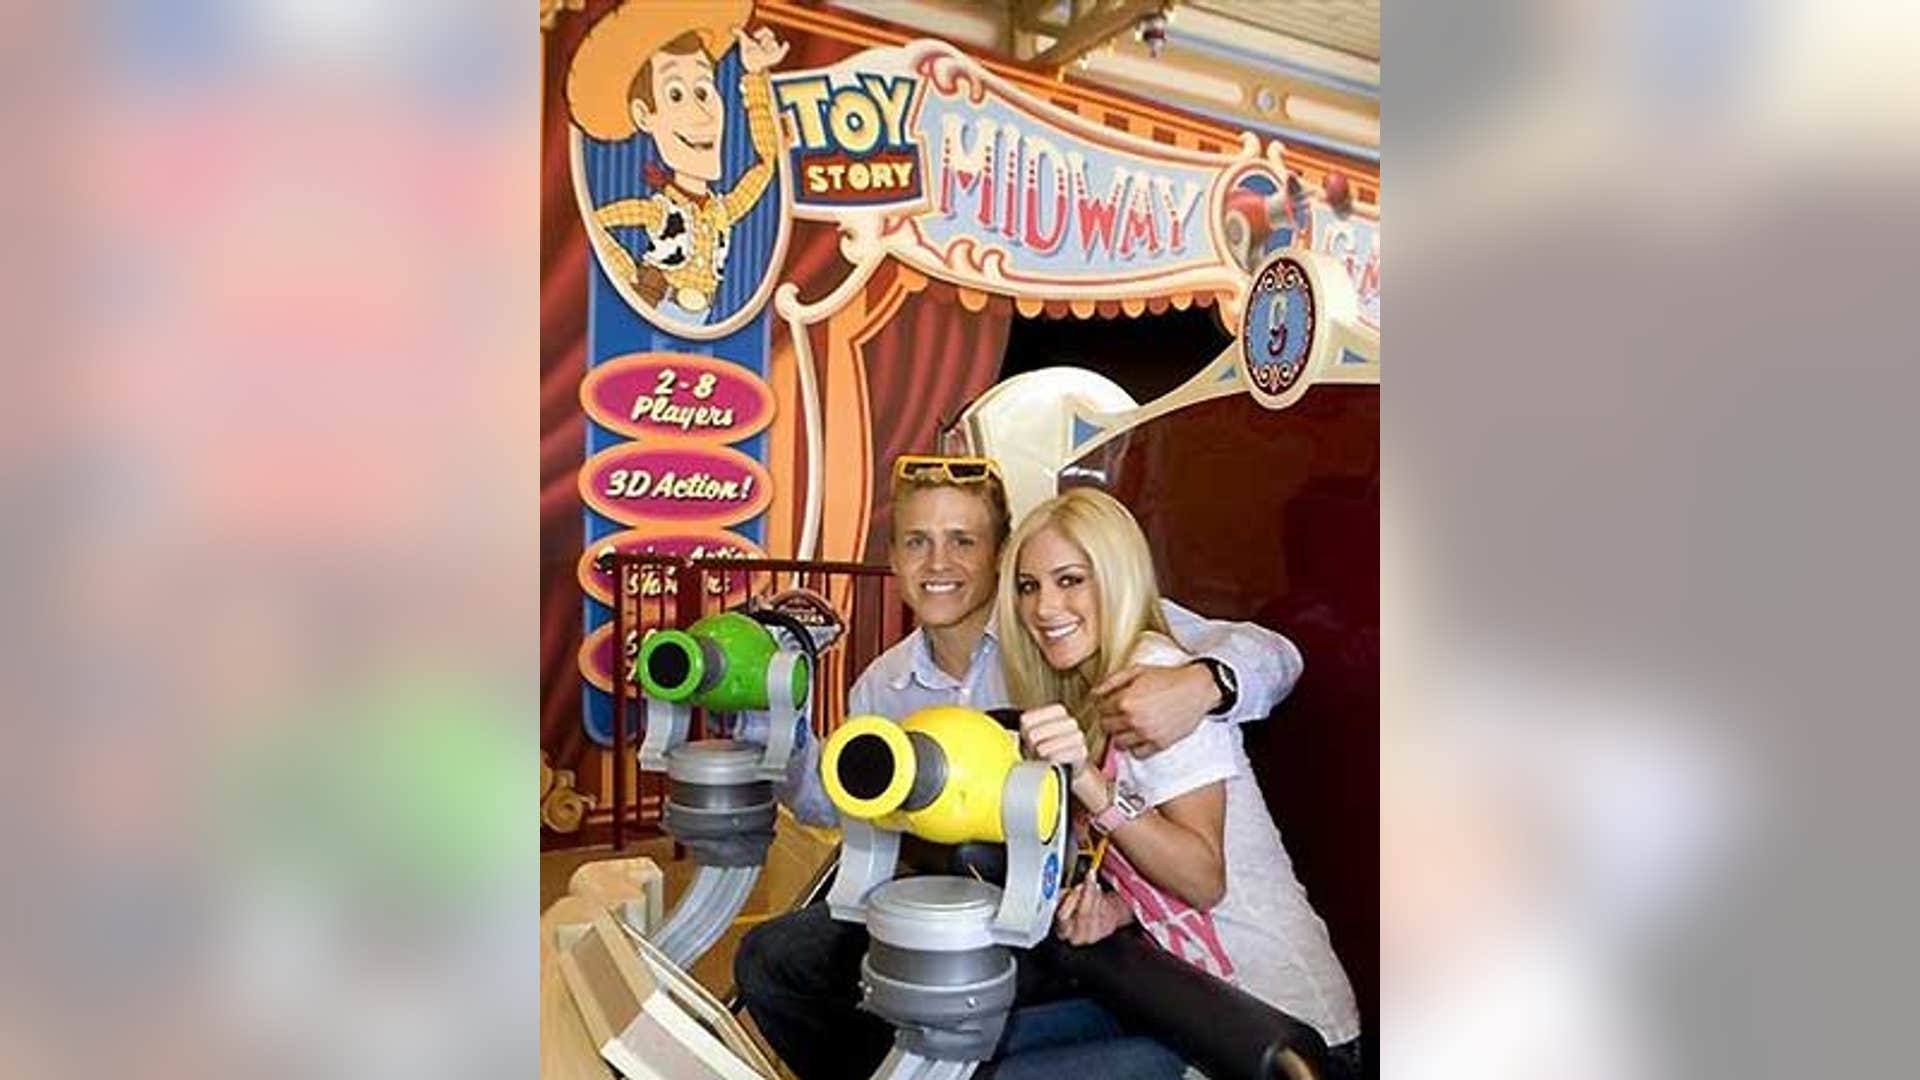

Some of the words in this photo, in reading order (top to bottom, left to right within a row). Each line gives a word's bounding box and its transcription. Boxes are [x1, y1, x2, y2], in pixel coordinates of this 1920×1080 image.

[774, 73, 915, 155] TOY
[807, 162, 914, 193] STORY
[937, 114, 1203, 258] MIDWAY
[630, 395, 735, 432] Players
[605, 469, 652, 498] 3D
[650, 471, 753, 500] Action!
